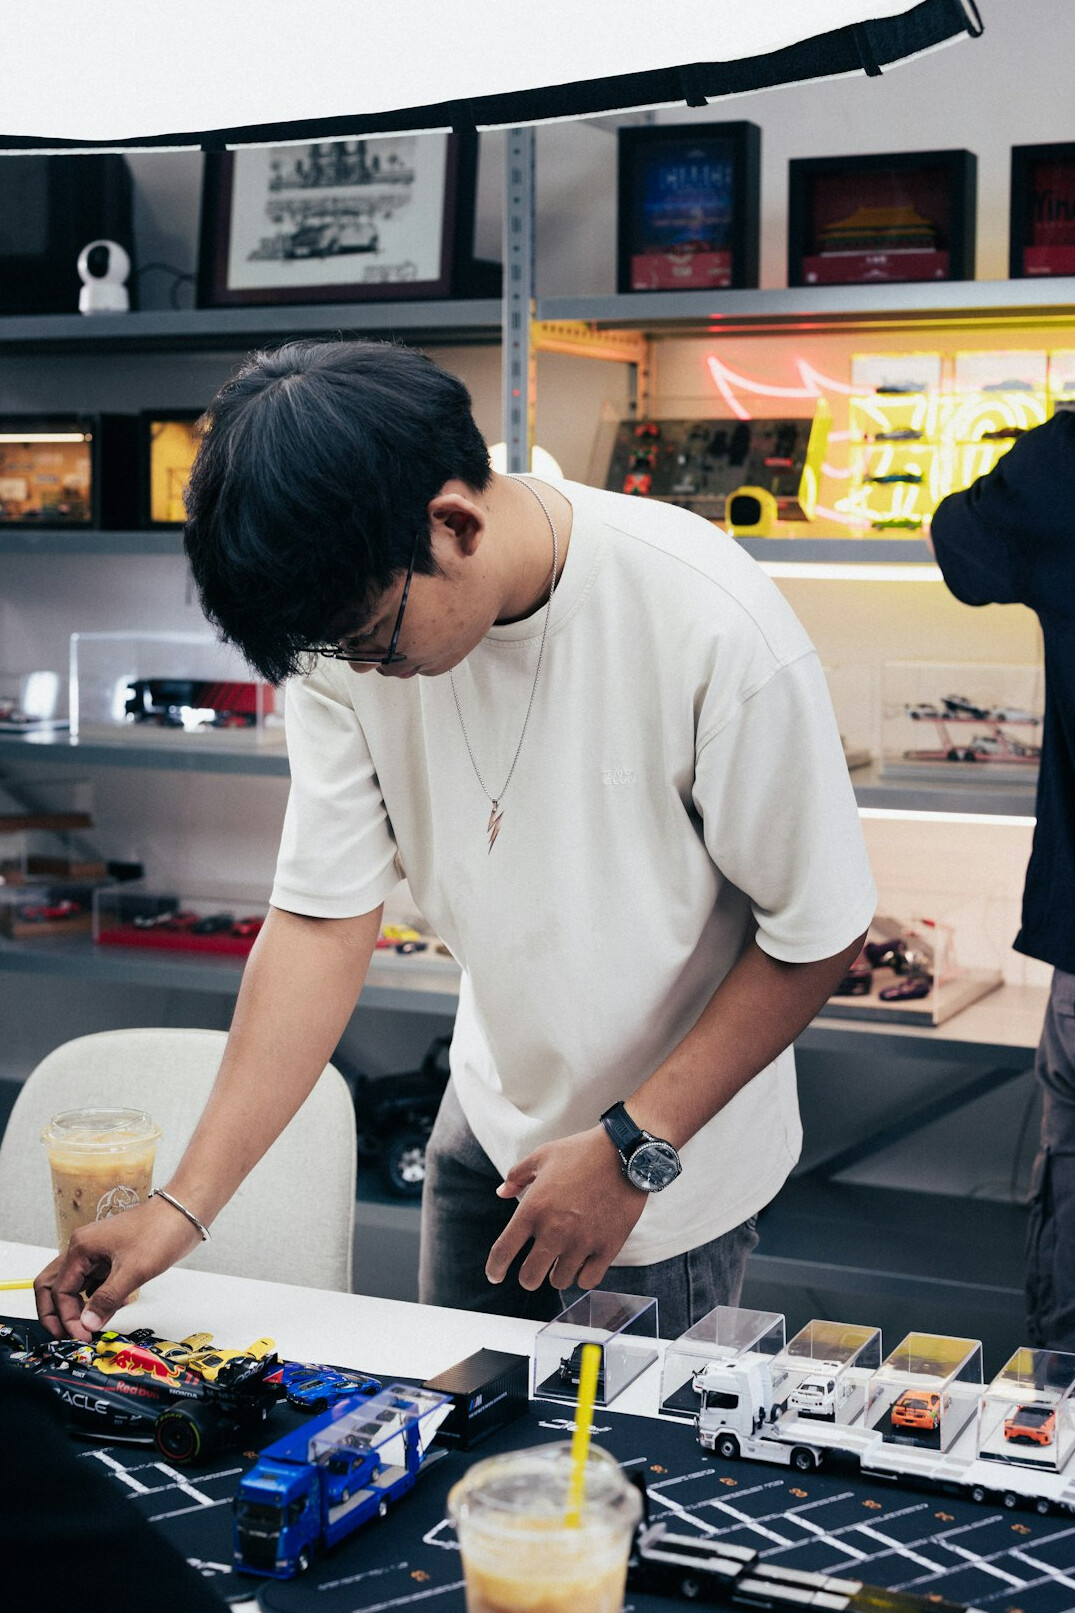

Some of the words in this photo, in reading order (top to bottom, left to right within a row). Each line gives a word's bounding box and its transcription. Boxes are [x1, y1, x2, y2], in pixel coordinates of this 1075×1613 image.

[116, 1380, 139, 1395] Red
[138, 1384, 160, 1399] Bull
[169, 1388, 198, 1399] HONDA
